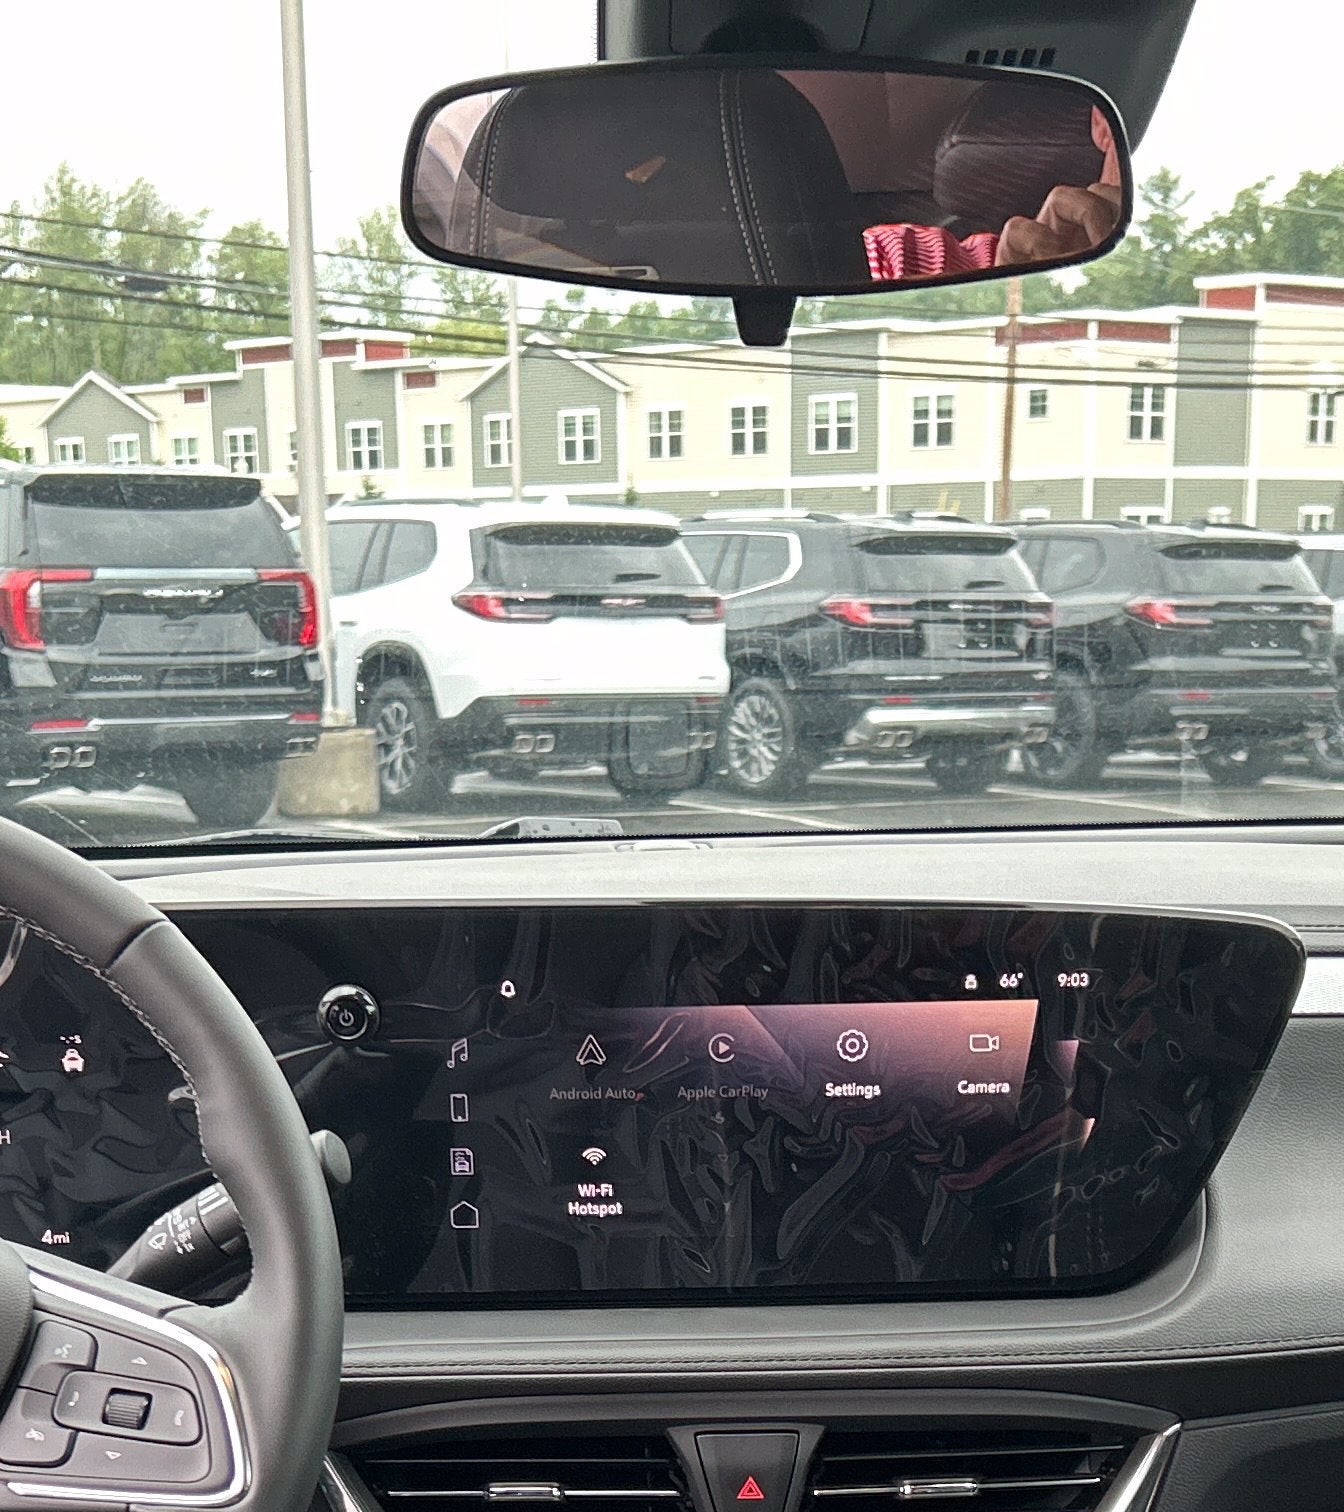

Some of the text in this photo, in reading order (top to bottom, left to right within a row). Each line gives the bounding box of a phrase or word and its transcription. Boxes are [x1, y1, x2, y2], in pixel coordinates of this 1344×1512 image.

[1057, 972, 1090, 988] 9:03
[550, 1087, 636, 1100] Android Auto
[677, 1085, 769, 1101] Apple CarPlay
[825, 1082, 881, 1099] Settings
[957, 1080, 1010, 1095] Camera
[577, 1183, 613, 1198] Wi-Fi
[568, 1201, 624, 1218] Hotspot
